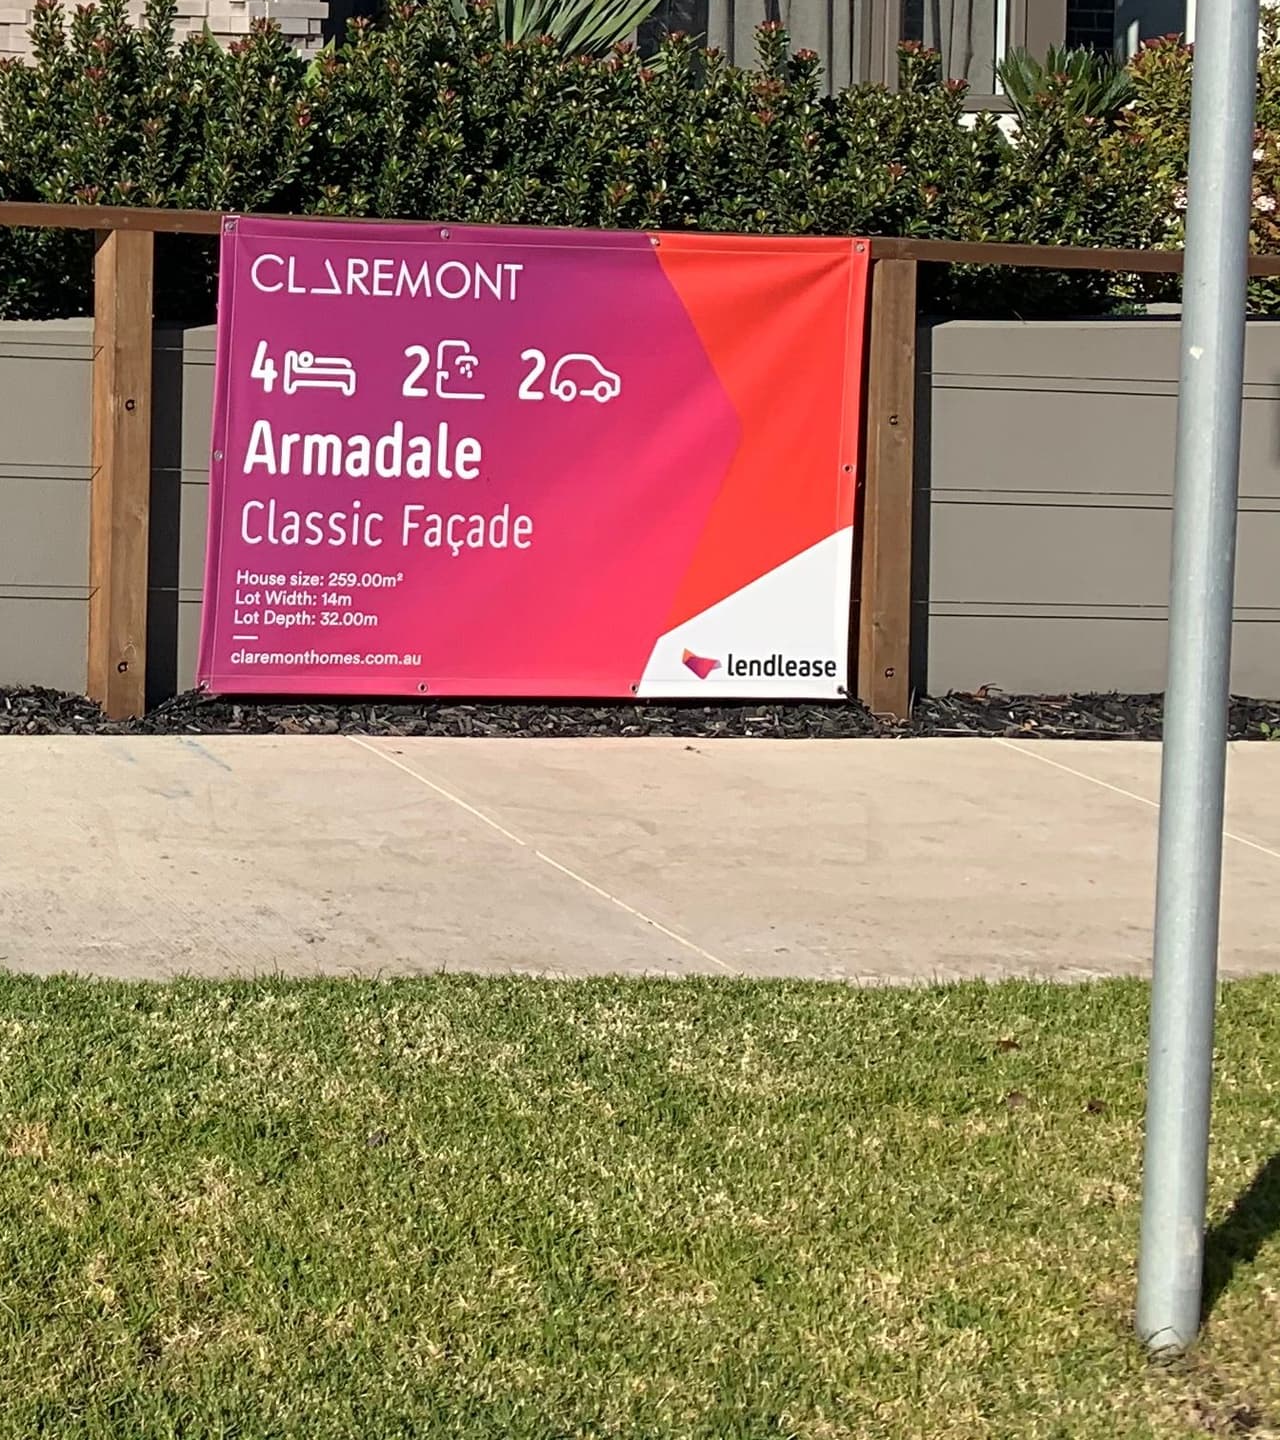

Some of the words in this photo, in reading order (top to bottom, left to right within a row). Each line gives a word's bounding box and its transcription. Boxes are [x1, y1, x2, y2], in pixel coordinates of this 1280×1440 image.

[251, 253, 524, 301] CLAREMONT
[250, 340, 278, 393] 4
[402, 345, 430, 397] 2
[518, 348, 546, 400] 2
[243, 420, 482, 480] Armadale
[241, 498, 384, 547] Classic
[402, 503, 534, 557] Façade
[236, 569, 286, 586] House
[290, 570, 325, 587] size:
[328, 571, 404, 588] 259.00m²
[235, 589, 261, 606] Lot
[265, 590, 317, 606] Width:
[321, 592, 352, 606] 14m
[233, 609, 259, 625] Lot
[264, 610, 316, 628] Depth:
[320, 612, 378, 626] 32.00m
[230, 648, 422, 666] claremonthomes.com.au
[727, 653, 837, 678] lendlease
